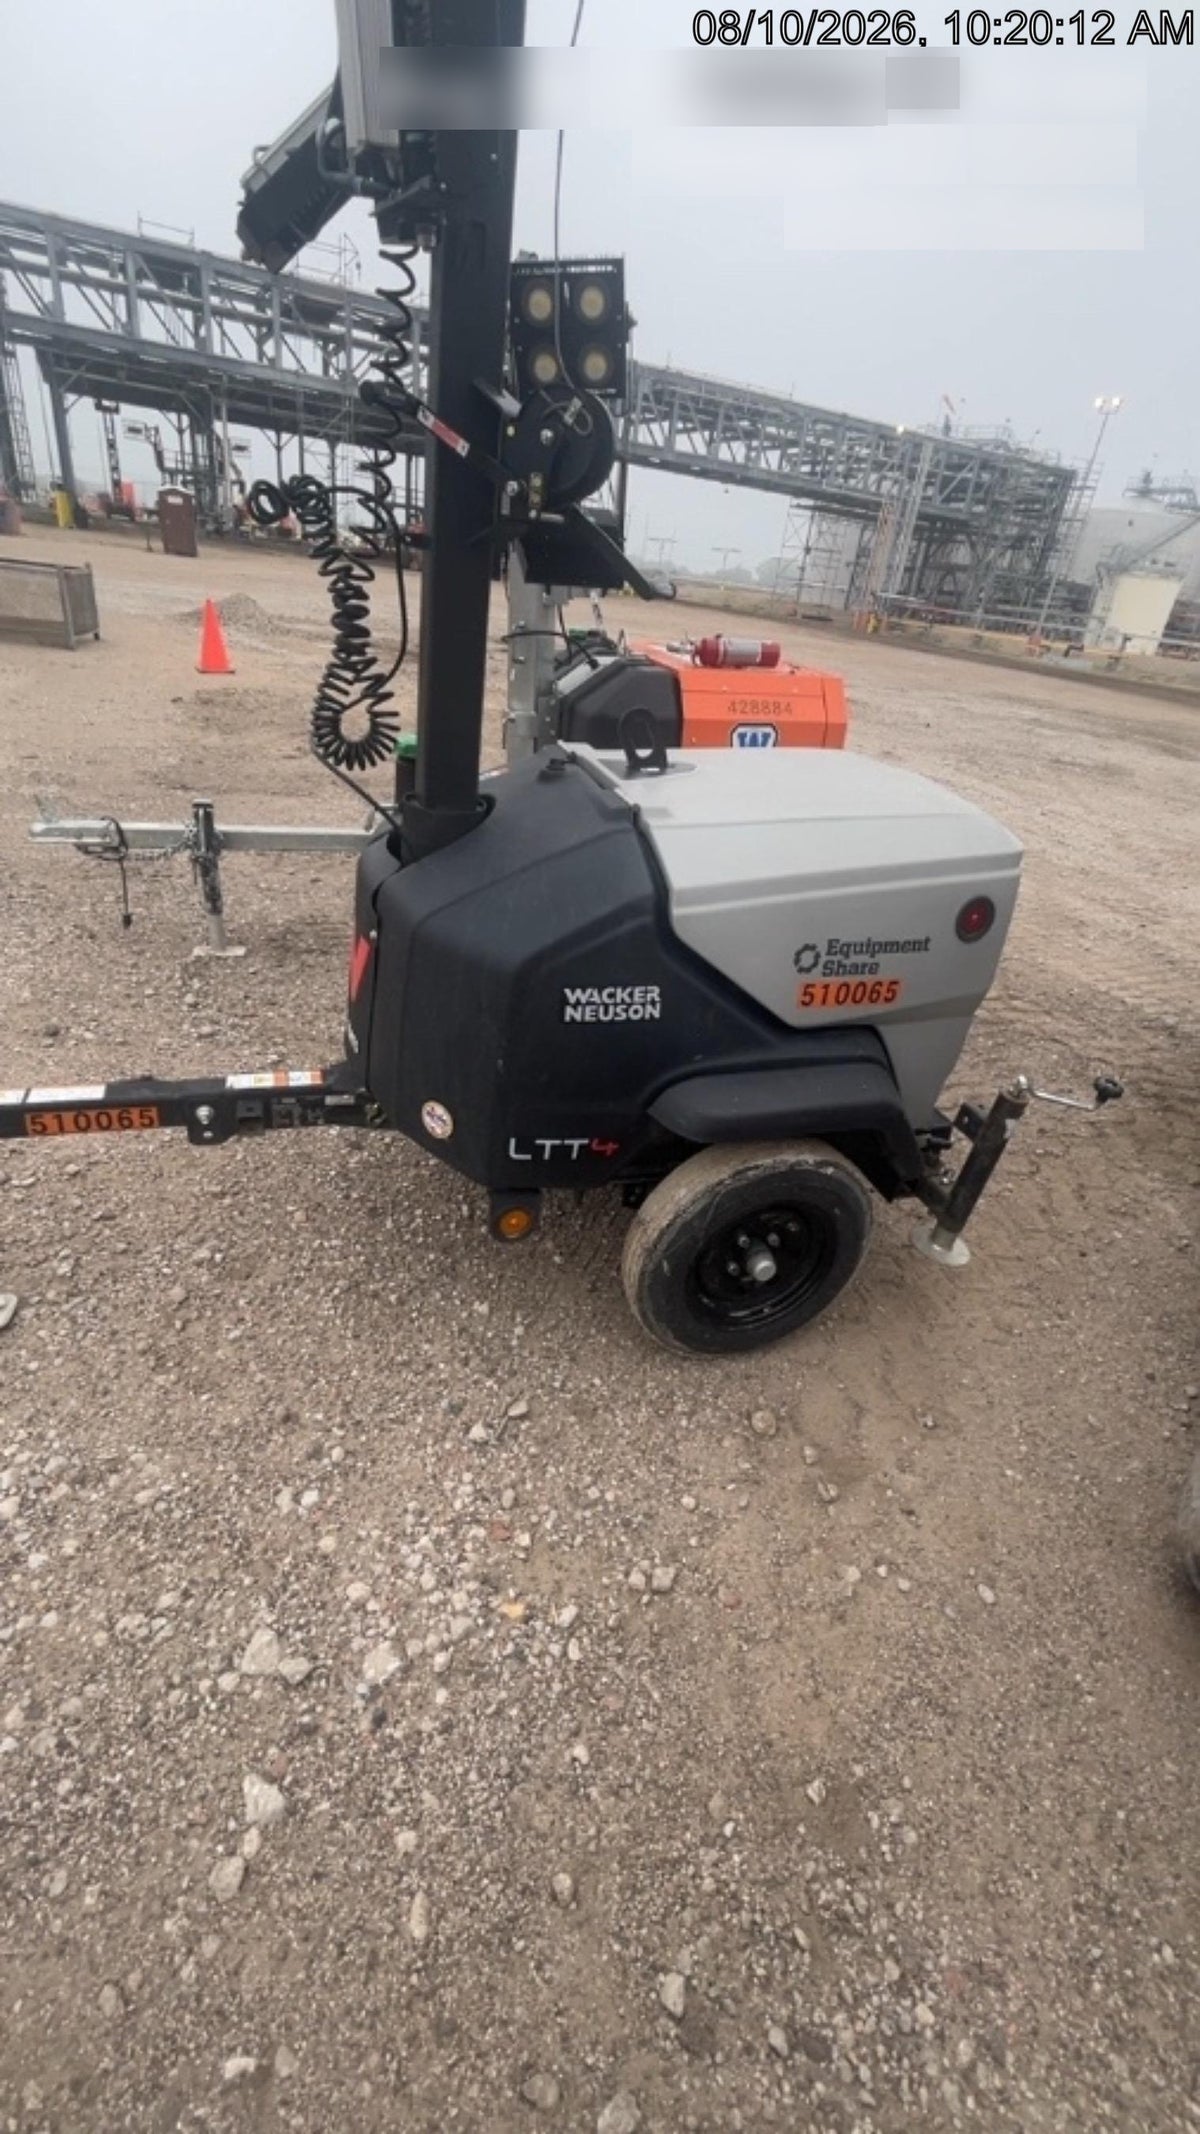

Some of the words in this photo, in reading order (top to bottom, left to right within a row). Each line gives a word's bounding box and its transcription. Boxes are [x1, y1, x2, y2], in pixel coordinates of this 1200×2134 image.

[727, 699, 793, 716] 428884
[824, 936, 931, 958] Equipment
[821, 959, 880, 977] Share
[563, 985, 661, 1004] WACKER
[800, 981, 900, 1006] 510065
[563, 1002, 661, 1022] NEUSON
[29, 1108, 156, 1134] 510065
[508, 1137, 620, 1160] LTT4
